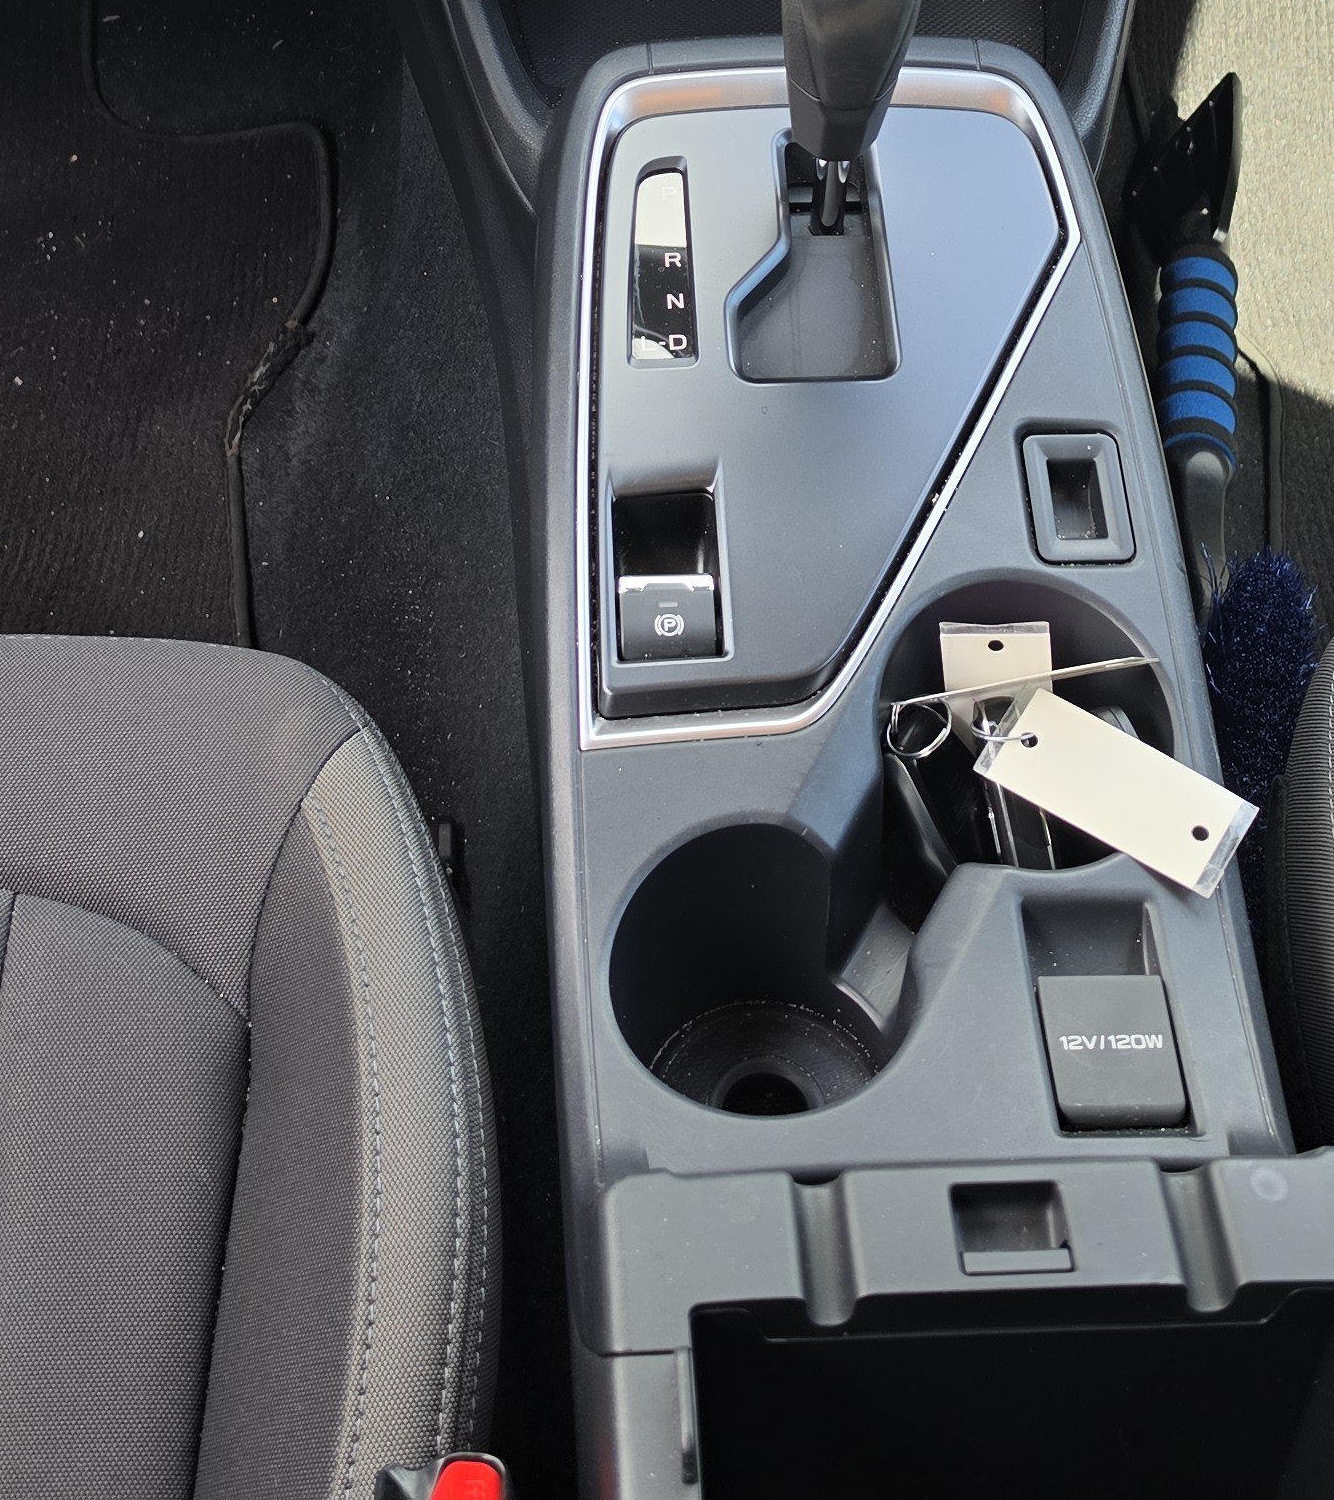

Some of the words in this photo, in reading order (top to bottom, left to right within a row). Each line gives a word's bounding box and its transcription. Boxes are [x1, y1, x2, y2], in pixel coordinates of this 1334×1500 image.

[661, 186, 676, 201] P
[664, 252, 682, 268] R
[667, 293, 685, 310] N
